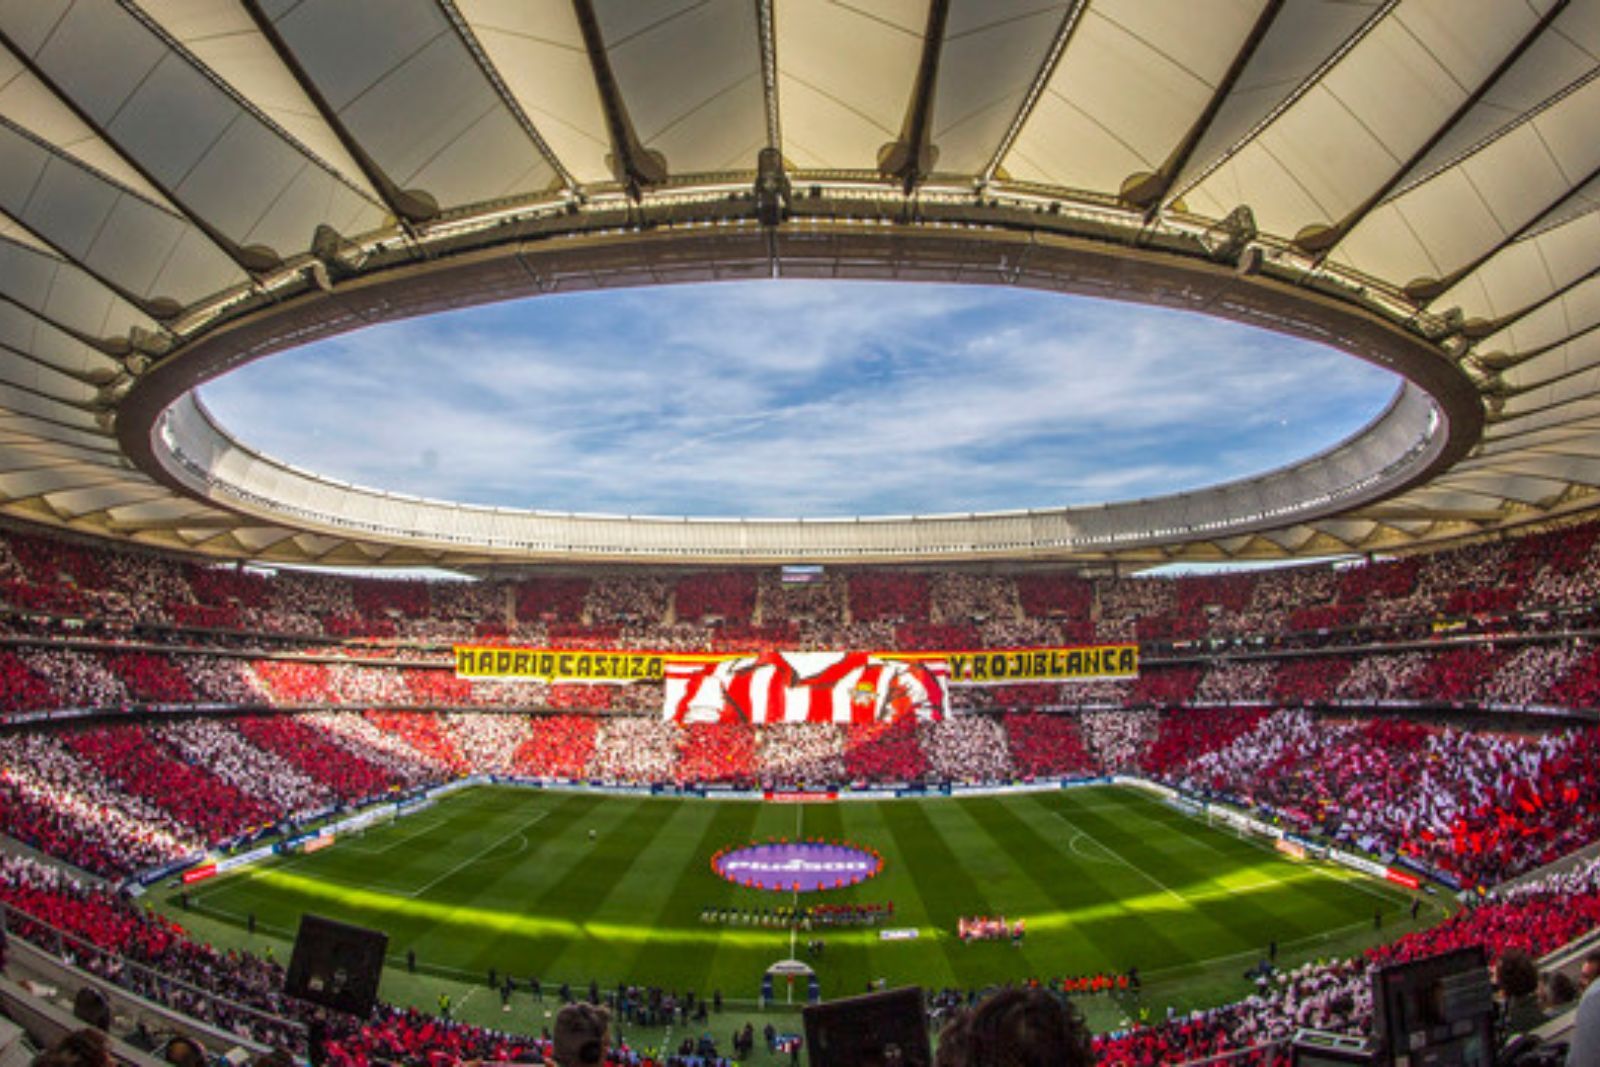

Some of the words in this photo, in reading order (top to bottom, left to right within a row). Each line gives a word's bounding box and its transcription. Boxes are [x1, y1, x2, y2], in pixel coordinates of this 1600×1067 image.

[458, 651, 554, 675] MADRID
[559, 654, 662, 678] CASTIZA
[950, 654, 964, 678] Y
[973, 648, 1134, 678] ROJIBLANCA
